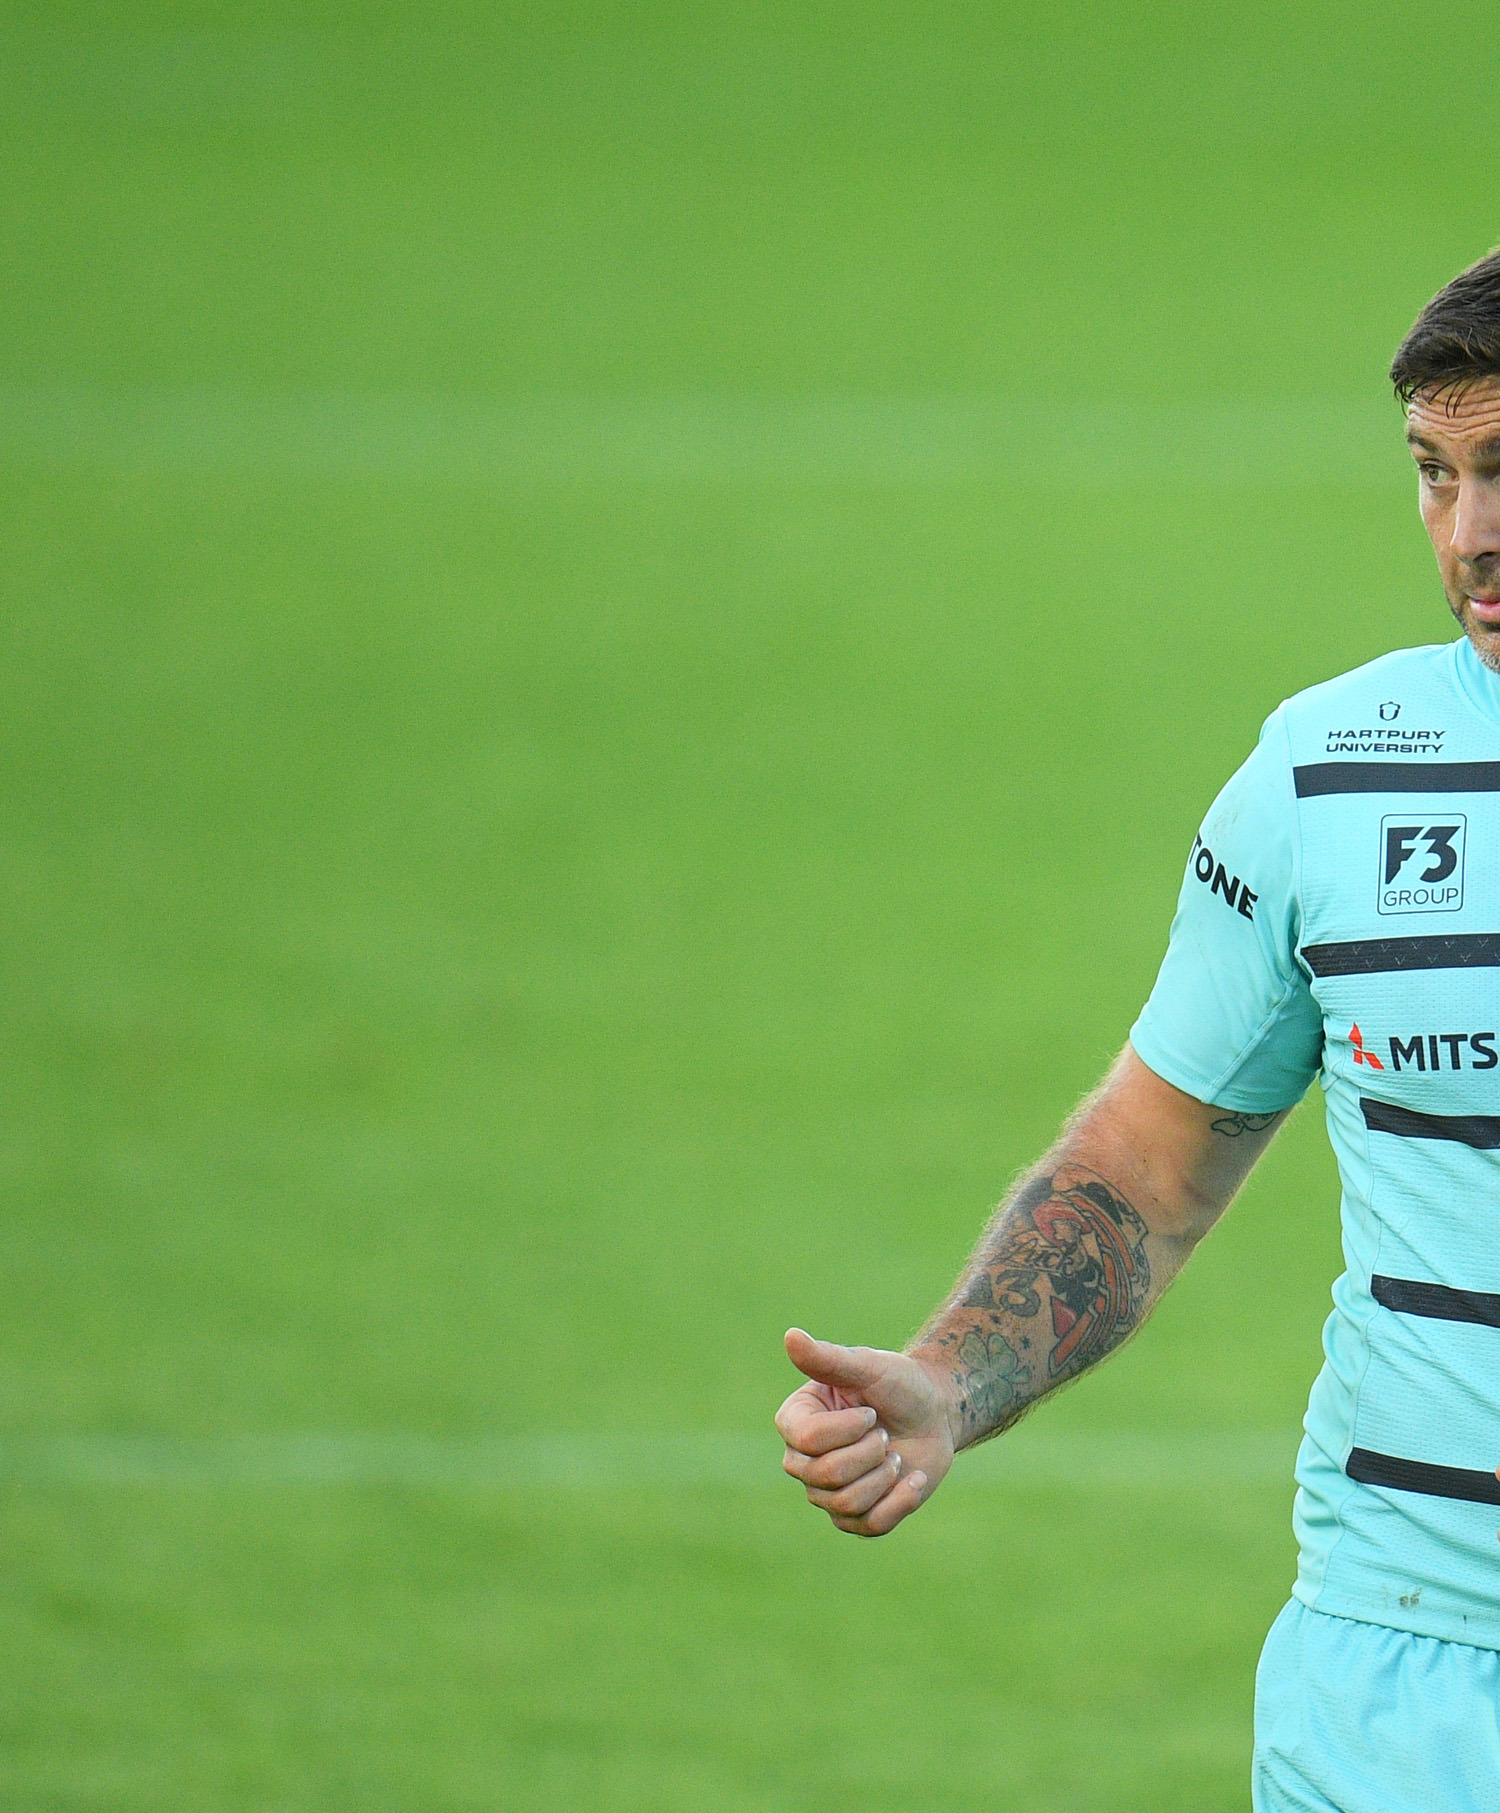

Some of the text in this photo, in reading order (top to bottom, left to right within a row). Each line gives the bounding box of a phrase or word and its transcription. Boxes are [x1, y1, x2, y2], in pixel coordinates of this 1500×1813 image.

[1328, 729, 1446, 740] HARTPURY
[1326, 743, 1444, 753] UNIVERSITY
[1385, 825, 1461, 885] F3
[1383, 887, 1459, 907] GROUP
